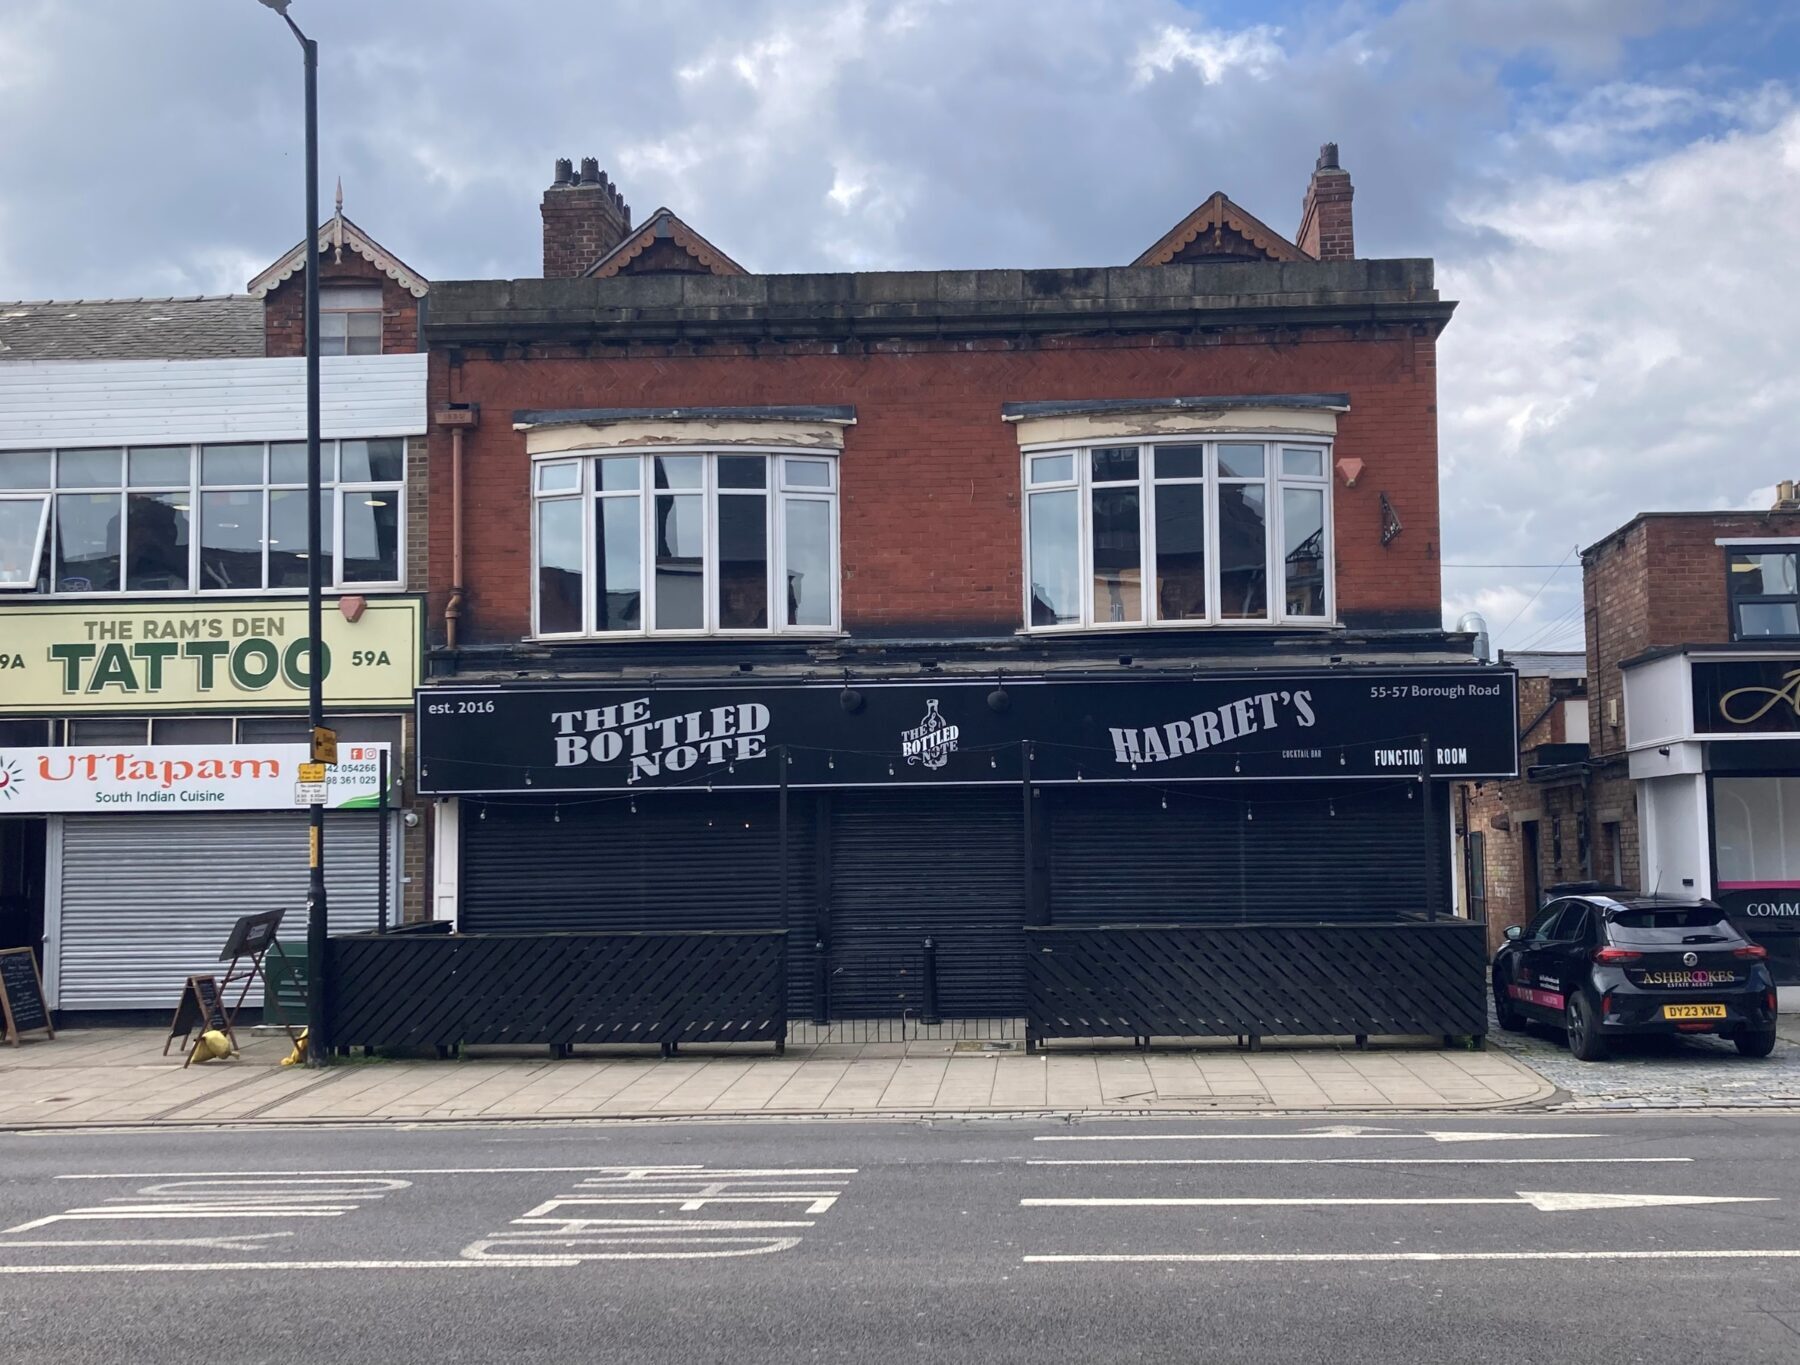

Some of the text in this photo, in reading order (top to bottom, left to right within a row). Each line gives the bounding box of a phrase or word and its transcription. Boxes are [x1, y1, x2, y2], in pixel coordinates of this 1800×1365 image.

[84, 617, 285, 640] THE RAM'S DEN
[47, 637, 332, 694] TATTOO
[351, 650, 391, 667] 59A
[1370, 684, 1500, 699] 55-57 Borough Road
[428, 701, 495, 715] est. 2016
[551, 698, 651, 735] THE
[554, 703, 771, 767] BOTTLED
[901, 724, 928, 742] THE
[1108, 690, 1316, 764] HARRIET'S
[902, 725, 959, 757] BOTTLED
[629, 735, 767, 783] NOTE
[922, 740, 959, 764] NOTE
[1311, 750, 1322, 758] BAR
[1437, 749, 1467, 764] ROOM
[341, 764, 377, 773] 054266
[340, 776, 357, 785] 361
[360, 775, 377, 784] 029
[95, 790, 225, 804] South Indian Cuisine
[1643, 971, 1735, 984] ASHBROOKES
[1669, 1007, 1698, 1017] DY23
[460, 1164, 858, 1262] AHEAD
